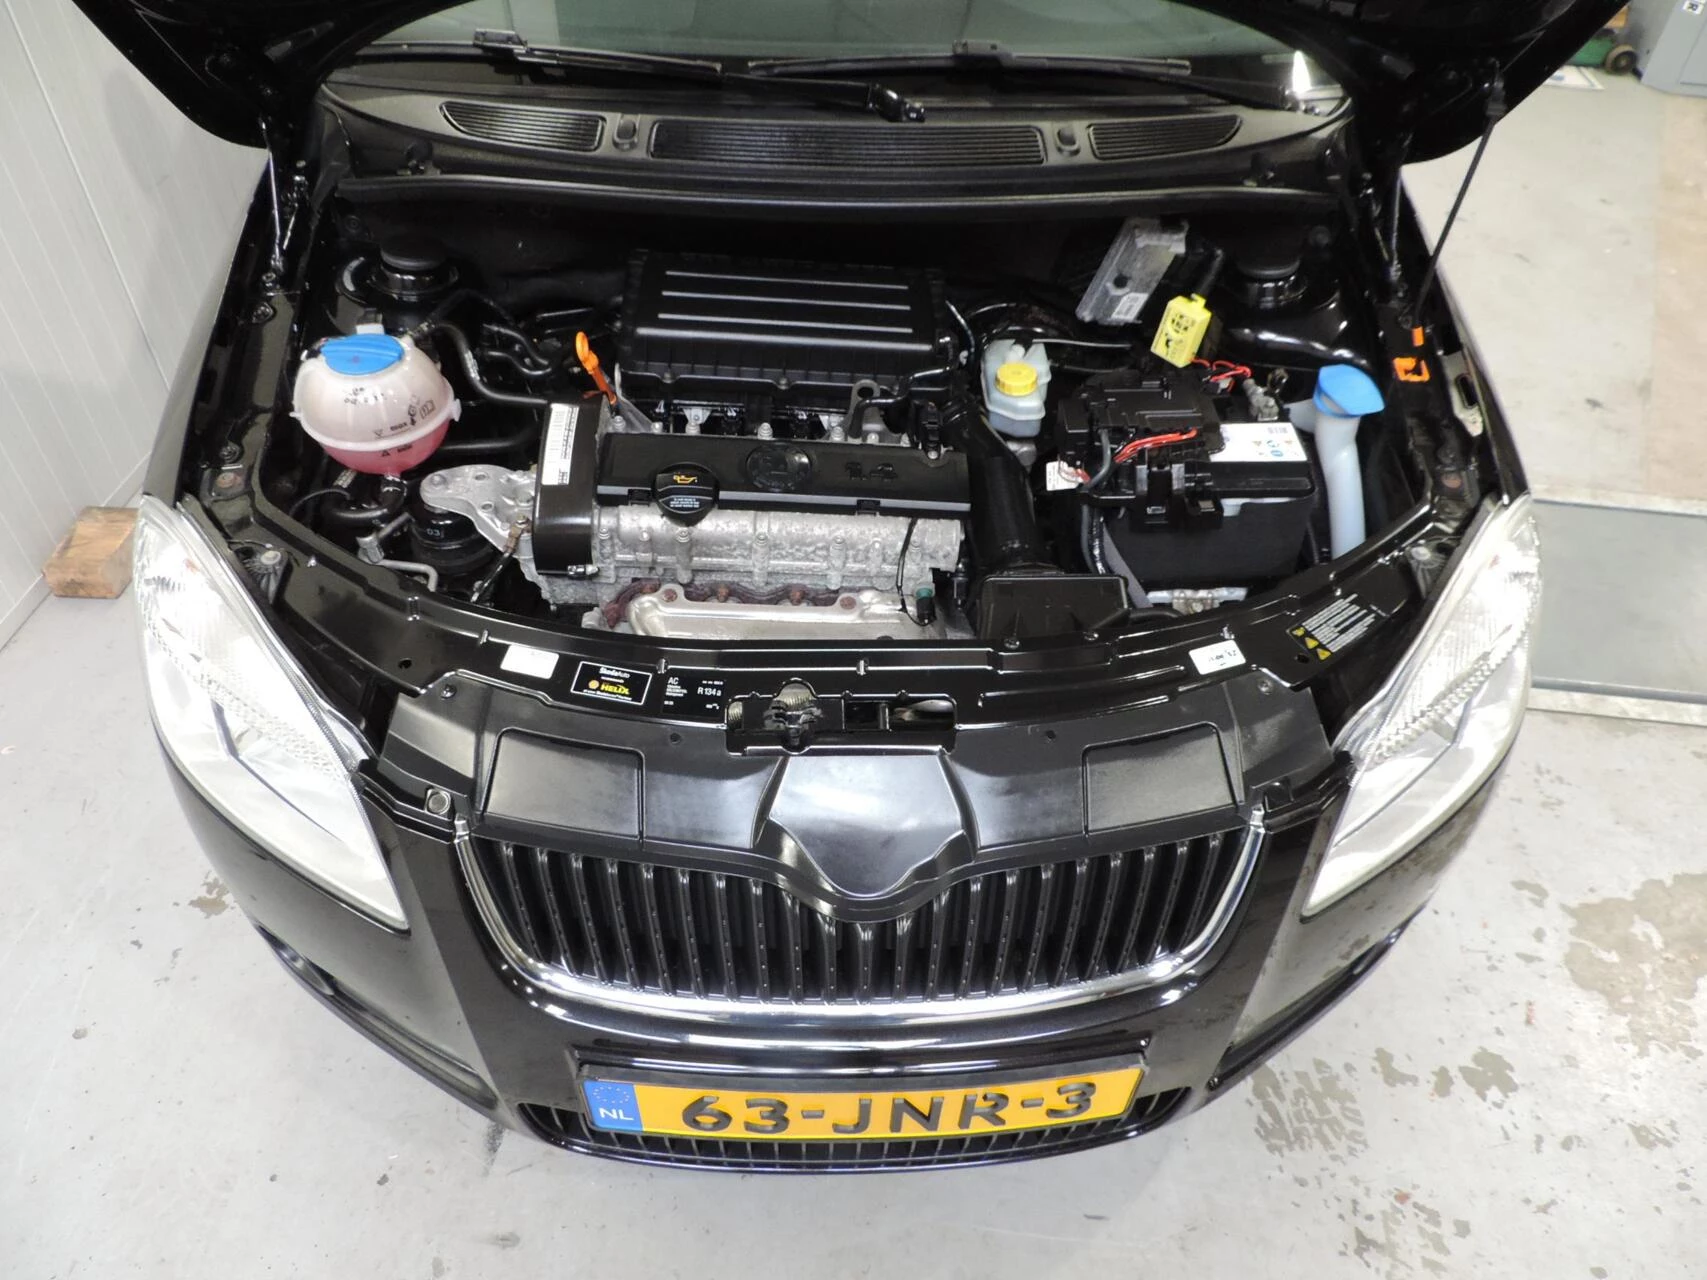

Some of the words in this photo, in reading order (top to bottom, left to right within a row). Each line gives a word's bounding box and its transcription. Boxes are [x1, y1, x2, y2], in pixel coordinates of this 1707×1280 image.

[668, 677, 679, 685] AC
[600, 683, 630, 695] HELIX
[599, 1107, 634, 1121] NL
[682, 1082, 1096, 1134] 63-JNR-3
